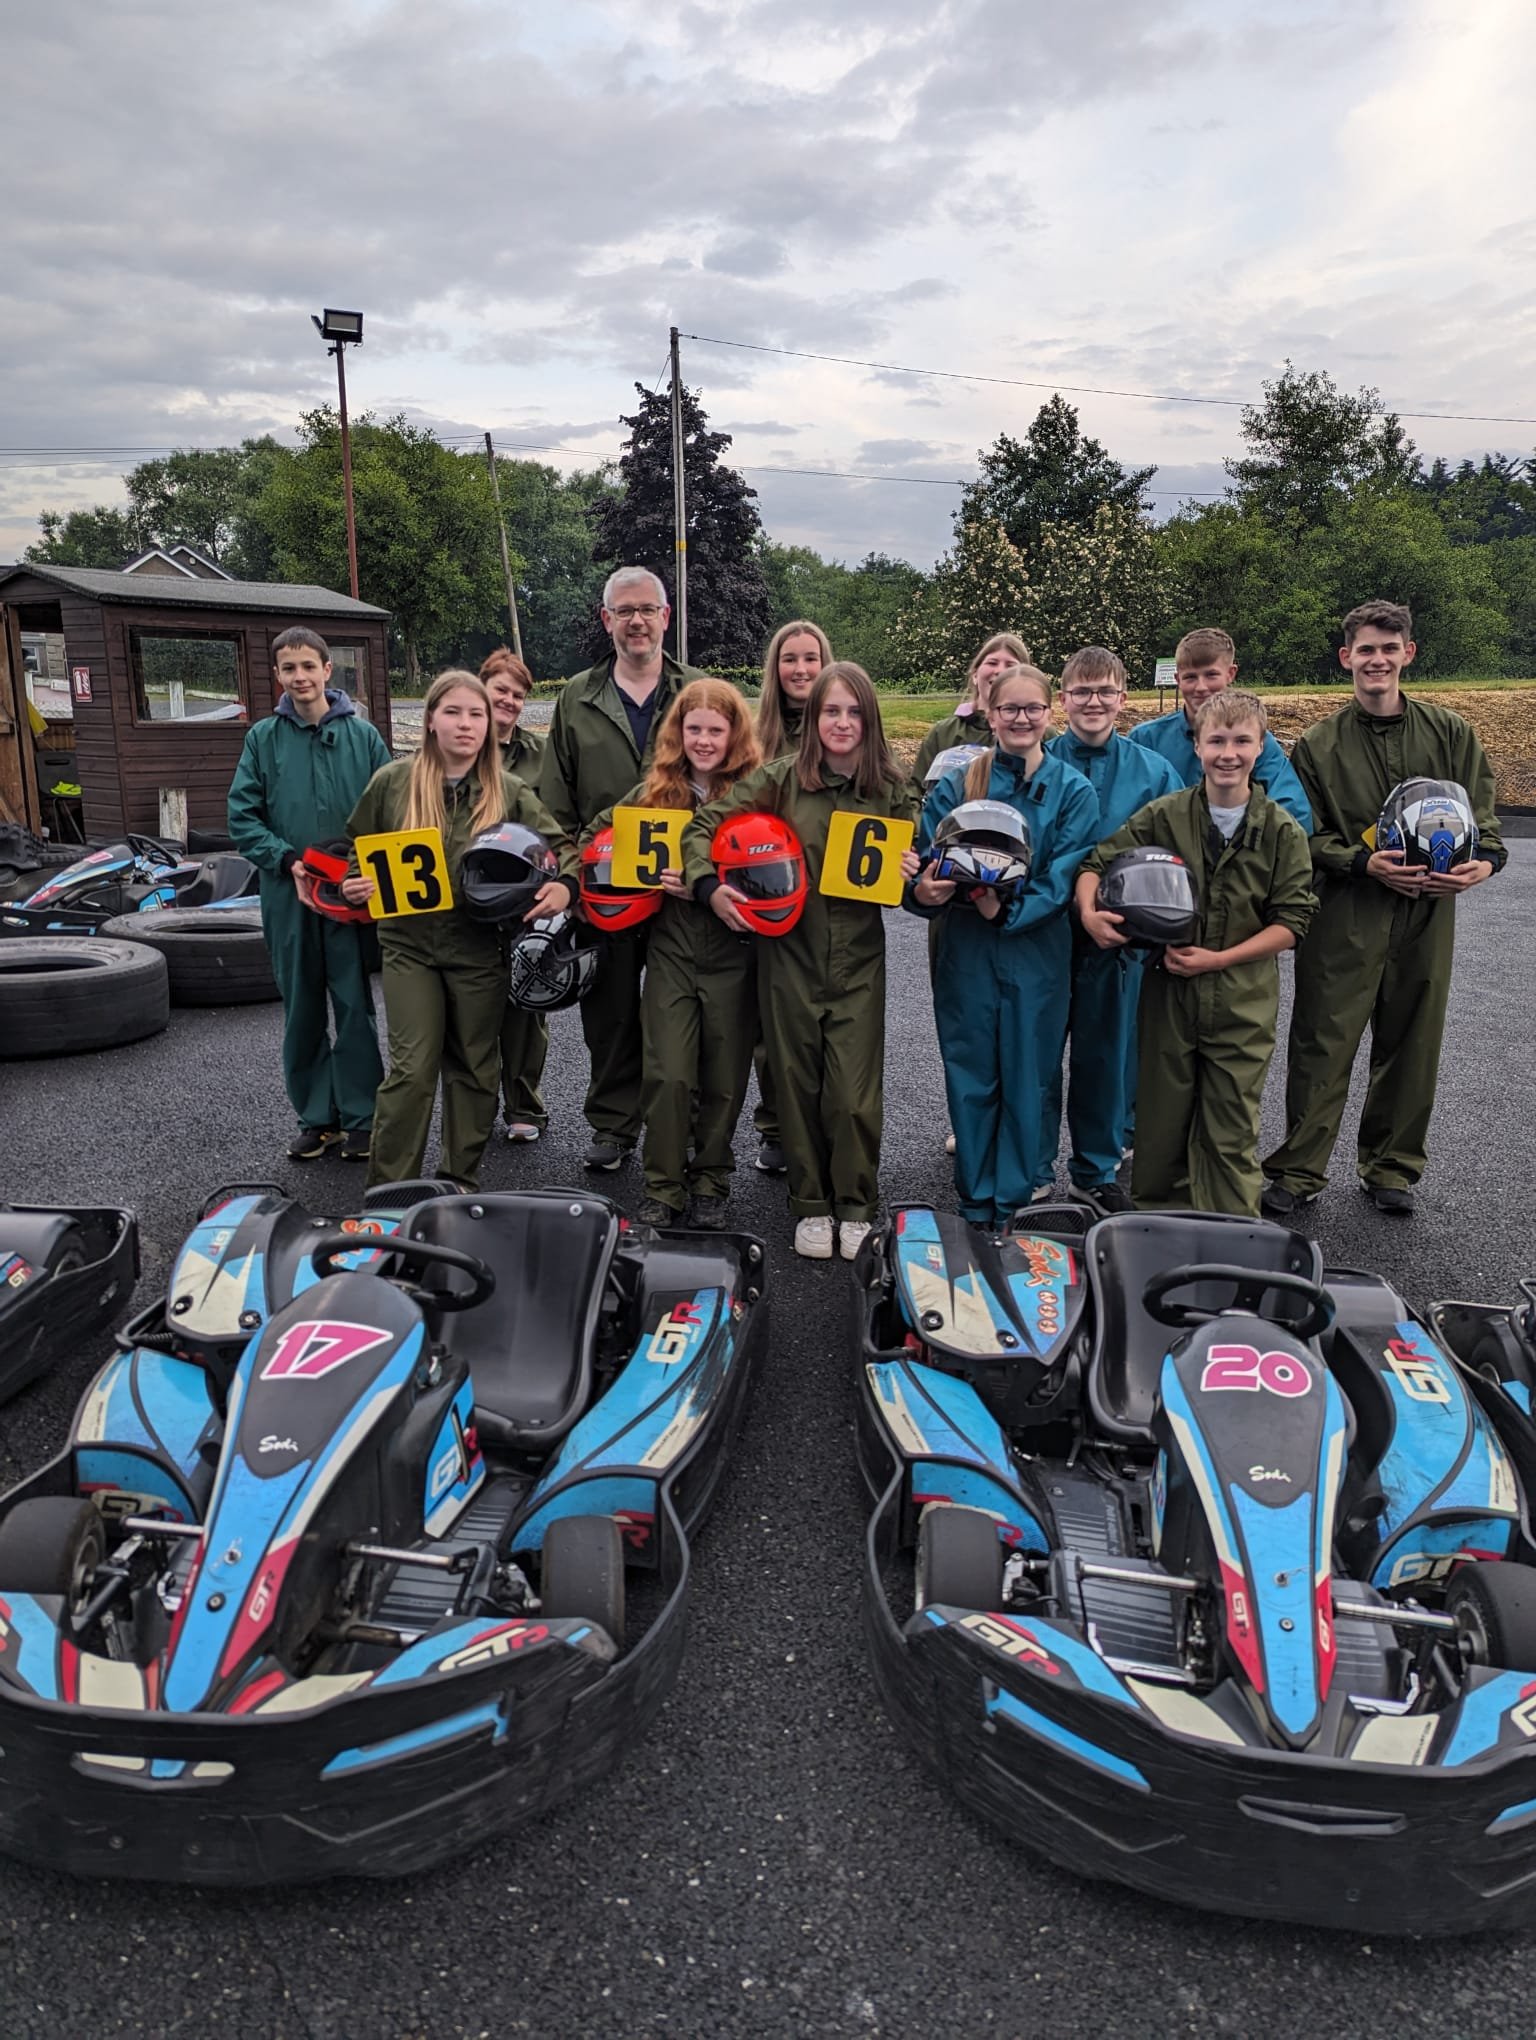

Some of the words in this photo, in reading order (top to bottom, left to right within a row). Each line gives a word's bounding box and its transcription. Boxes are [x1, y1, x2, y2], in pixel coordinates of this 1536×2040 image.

[366, 843, 442, 915] 13
[636, 820, 670, 886] 5
[846, 818, 888, 889] 6
[259, 1320, 394, 1380] 17
[1200, 1344, 1313, 1397] 20
